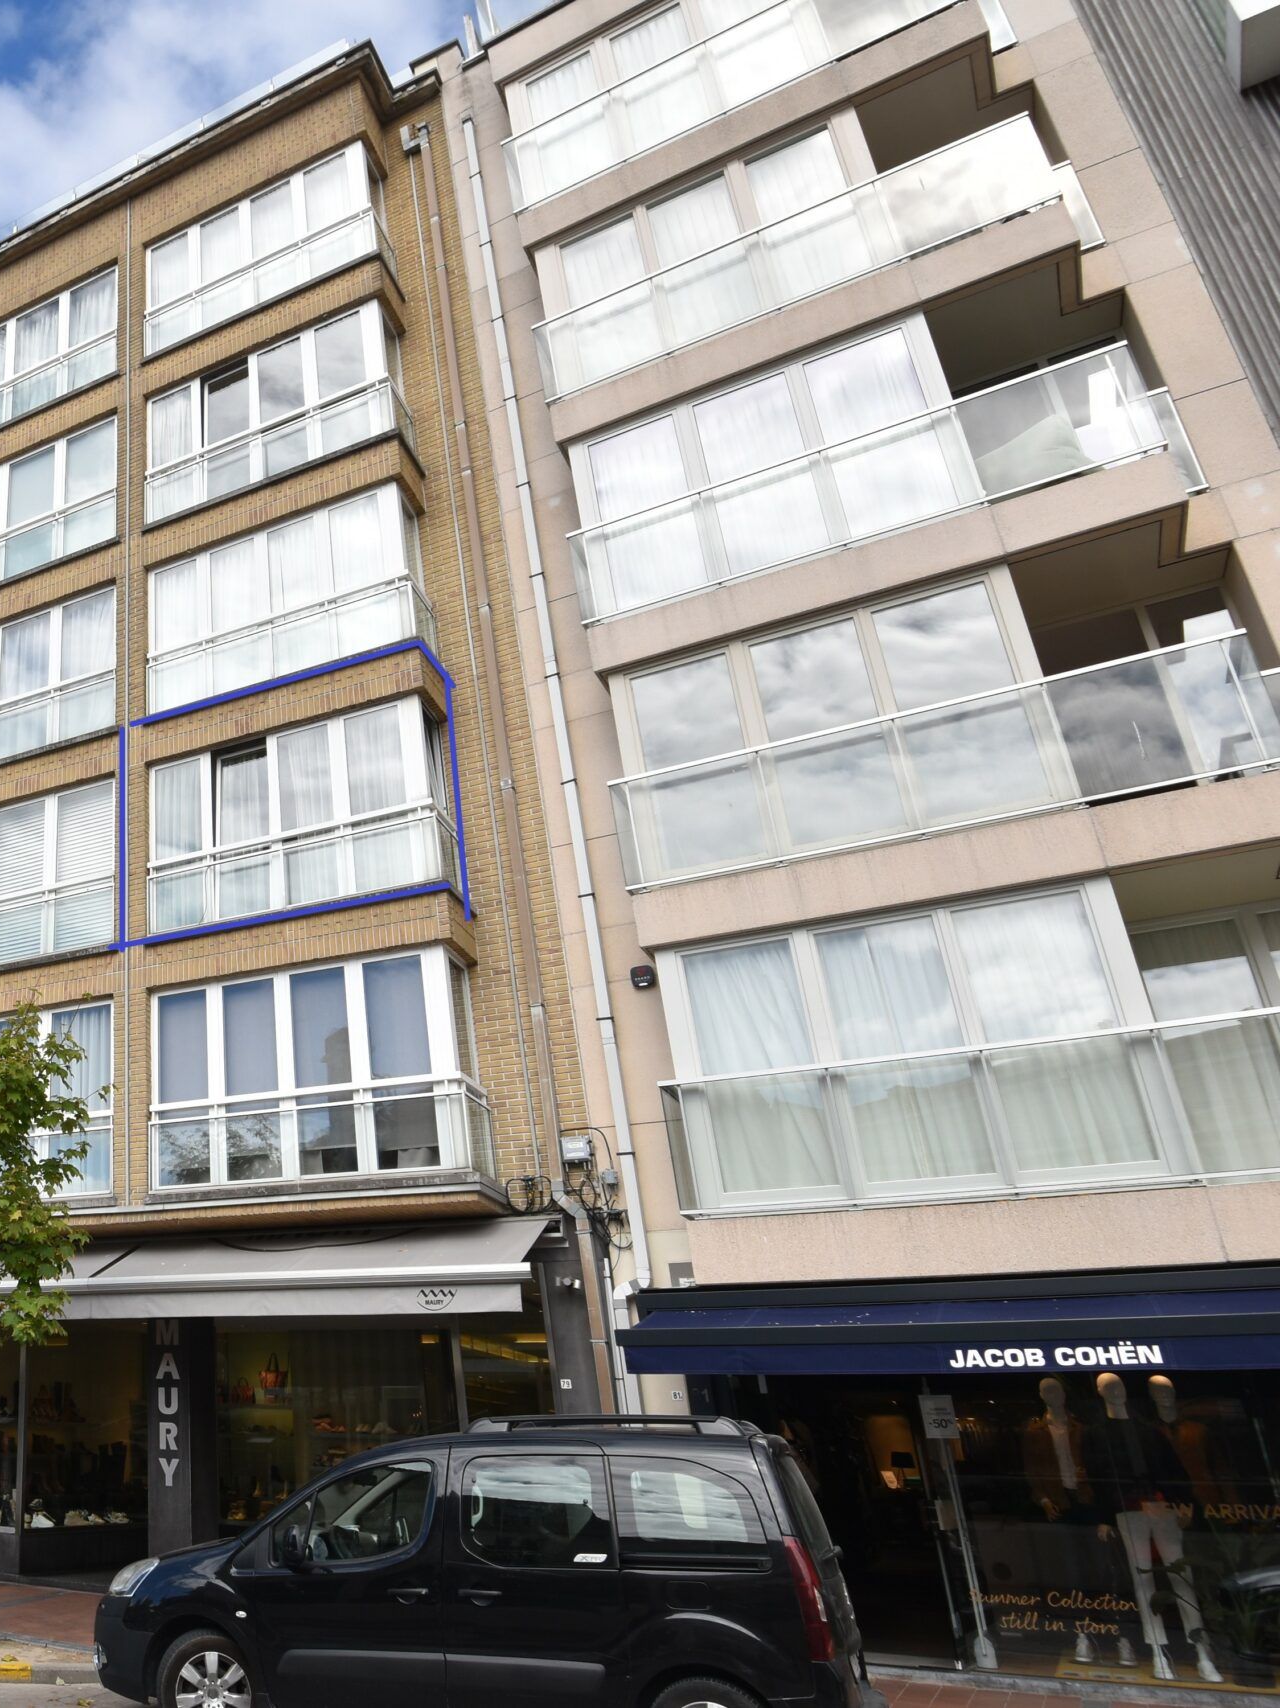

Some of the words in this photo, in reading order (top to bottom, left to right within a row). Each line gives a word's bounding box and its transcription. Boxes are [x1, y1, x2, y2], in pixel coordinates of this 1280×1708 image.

[949, 1347, 1046, 1369] JACOB
[1054, 1340, 1164, 1367] COHËN
[561, 1380, 571, 1389] 79
[155, 1318, 181, 1487] MAURY
[969, 1588, 1041, 1607] Summer
[1047, 1589, 1140, 1613] Collection
[1000, 1611, 1039, 1631] still
[1044, 1614, 1067, 1632] in
[1074, 1616, 1120, 1636] store
